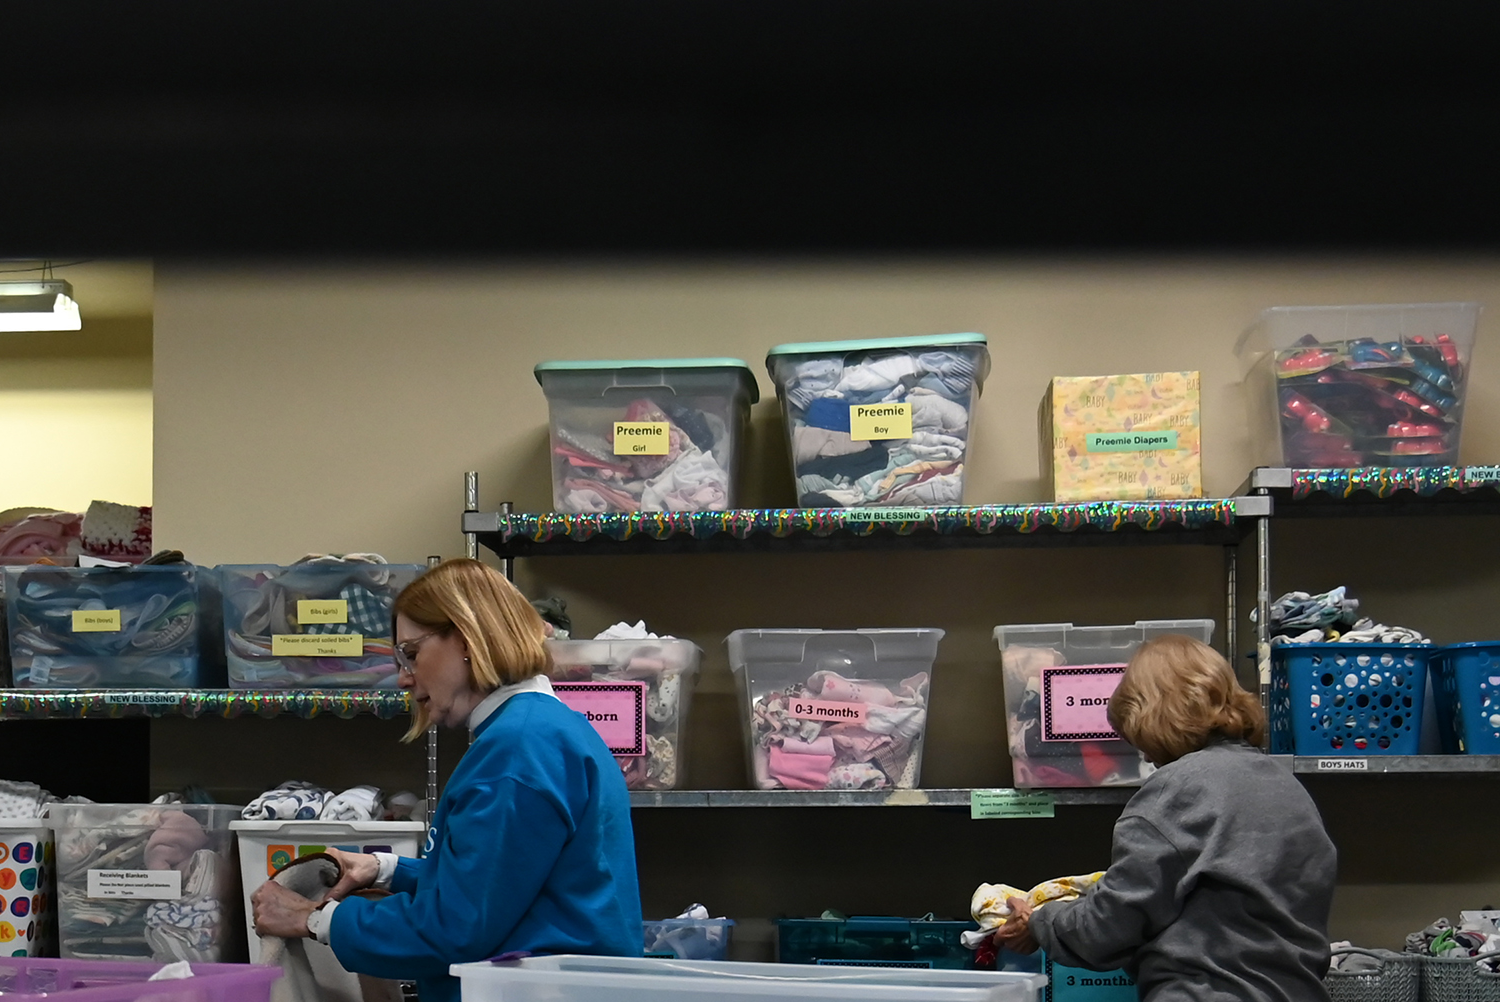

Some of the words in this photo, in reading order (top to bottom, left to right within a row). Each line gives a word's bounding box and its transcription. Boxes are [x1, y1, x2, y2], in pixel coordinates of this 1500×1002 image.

[1187, 379, 1200, 391] BAB
[1086, 395, 1106, 408] BABY
[857, 405, 904, 418] Preemie
[1169, 415, 1189, 427] BABY
[616, 425, 663, 437] Preemie
[874, 426, 889, 435] Boy
[1054, 437, 1068, 449] ABY
[1095, 437, 1132, 446] Preemie
[1134, 436, 1168, 446] Diapers
[632, 444, 647, 453] Girl
[1118, 471, 1138, 484] BABY
[1170, 473, 1190, 486] BABY
[1471, 470, 1494, 479] NEW
[850, 511, 870, 521] NEW
[873, 510, 921, 521] BLESSING
[109, 694, 130, 703] NEW
[132, 694, 176, 703] BLESSING
[1066, 696, 1075, 707] 3
[1080, 697, 1110, 706] mon
[587, 711, 618, 722] born
[795, 703, 814, 715] 0-3
[816, 706, 859, 719] months
[1320, 761, 1342, 769] BOYS
[1343, 761, 1365, 769] HATS
[1066, 975, 1076, 986] 3
[1080, 975, 1135, 987] months
